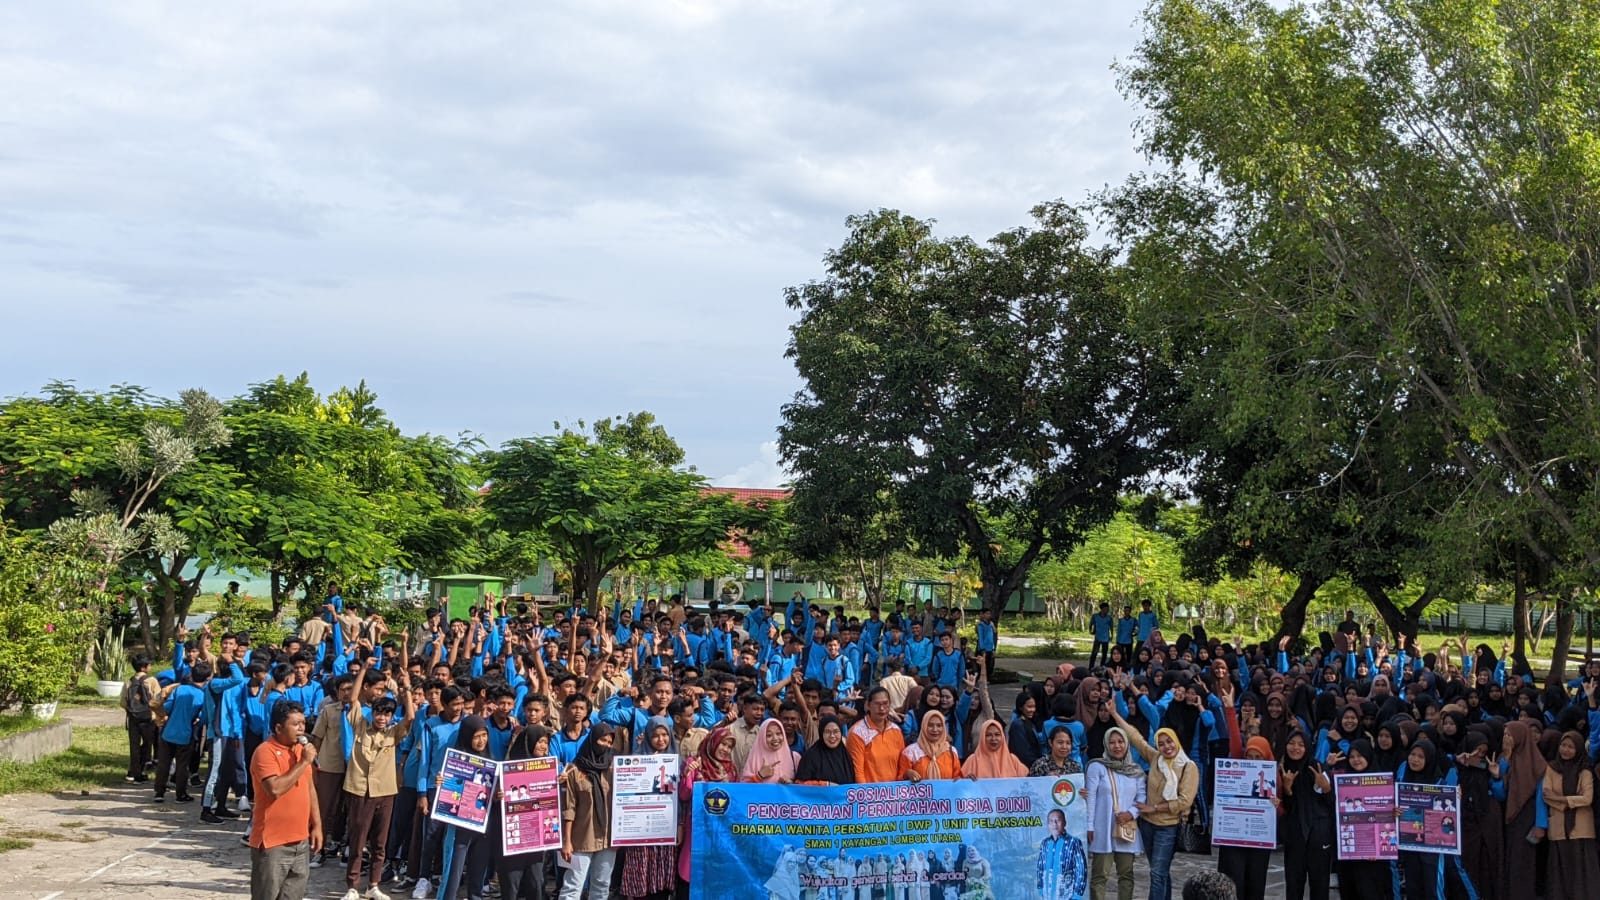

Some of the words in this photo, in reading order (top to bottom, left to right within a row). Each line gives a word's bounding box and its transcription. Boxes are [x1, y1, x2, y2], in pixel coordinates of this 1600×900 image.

[847, 785, 932, 802] SOSIALISASI
[748, 804, 852, 819] PENCEGAHAN
[858, 800, 950, 818] PERNIKAHAN
[956, 798, 993, 814] USIA
[996, 796, 1031, 812] DINI
[732, 824, 782, 835] DHARMA
[786, 824, 831, 835] WANITA
[834, 820, 896, 834] PERSATUAN
[906, 820, 932, 831] DWP
[943, 818, 970, 830] UNIT
[972, 816, 1042, 829] PELAKSANA
[804, 839, 832, 848] SMAN
[834, 838, 838, 848] 1
[842, 837, 888, 848] KAYANGAN
[890, 834, 928, 845] LOMBOK
[930, 833, 962, 843] UTARA
